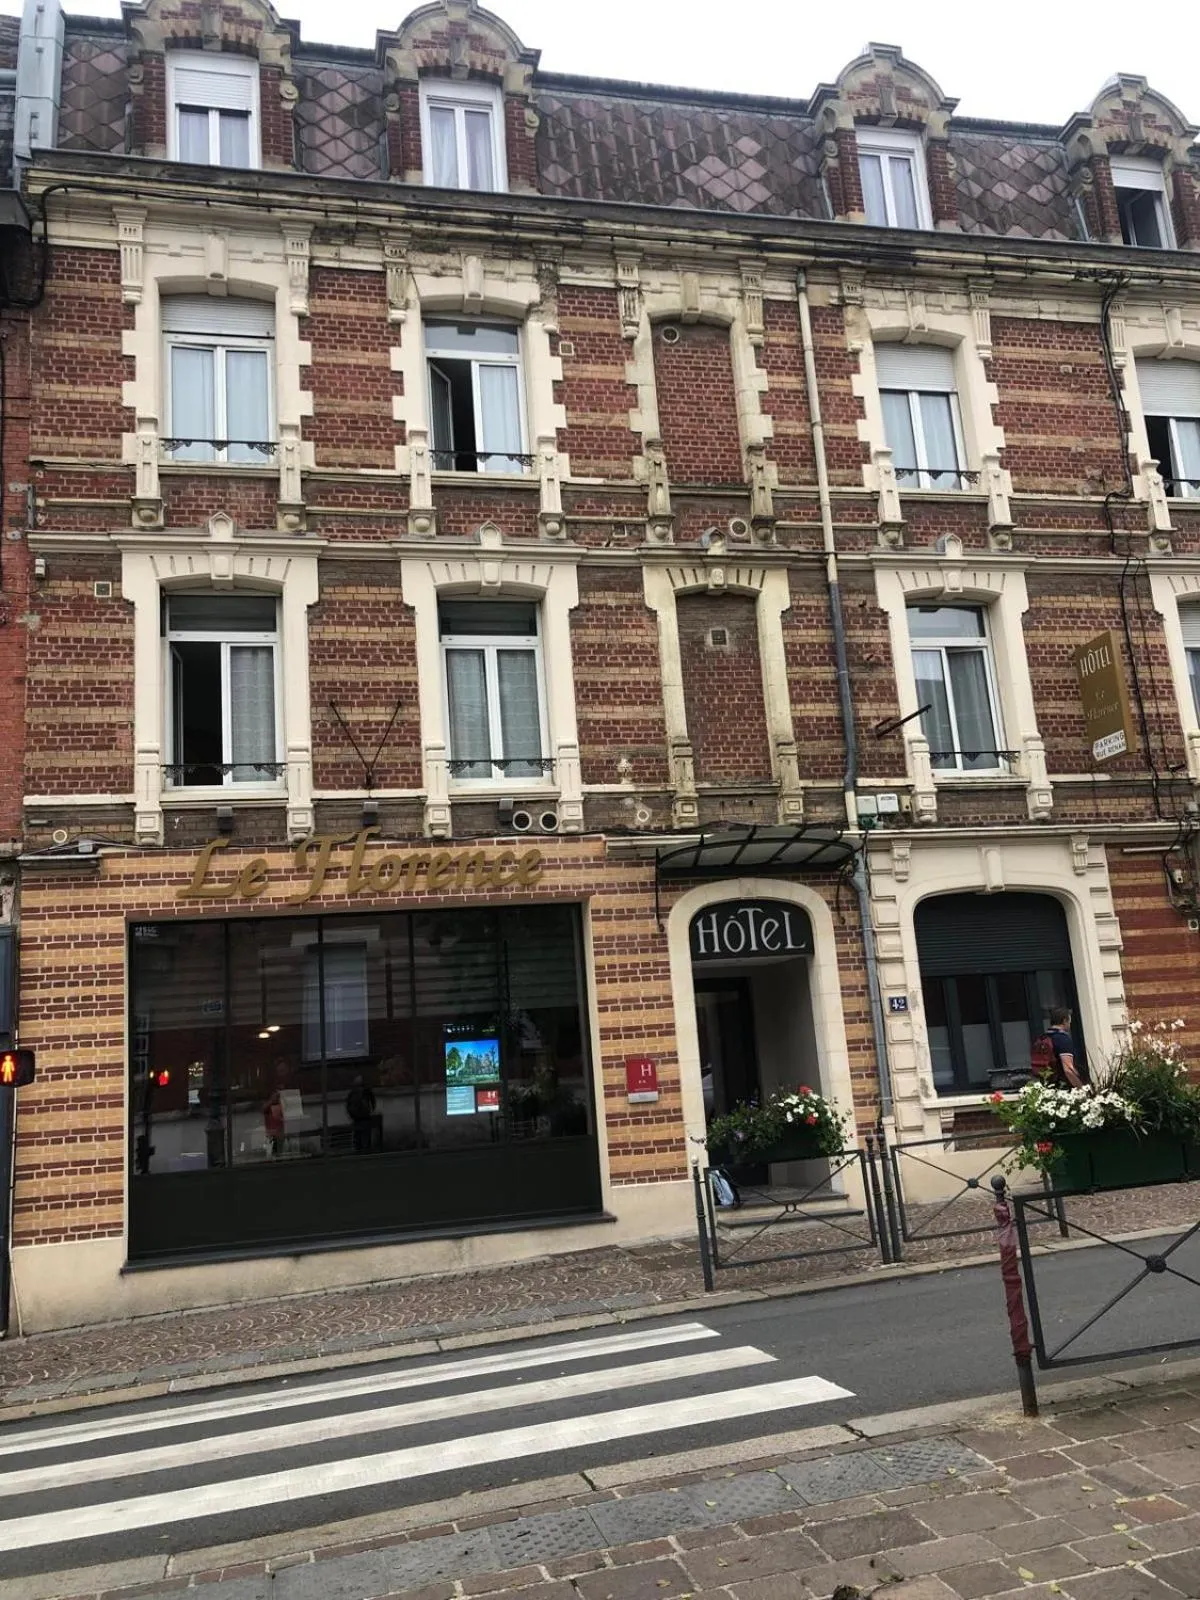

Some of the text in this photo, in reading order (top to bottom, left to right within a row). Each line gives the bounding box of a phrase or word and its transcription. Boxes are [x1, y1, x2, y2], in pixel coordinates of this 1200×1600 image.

[1080, 645, 1112, 678] HÔTEL
[1095, 732, 1124, 748] PARKING
[175, 826, 544, 905] Le Florence
[892, 998, 905, 1009] 42
[641, 1064, 652, 1076] H
